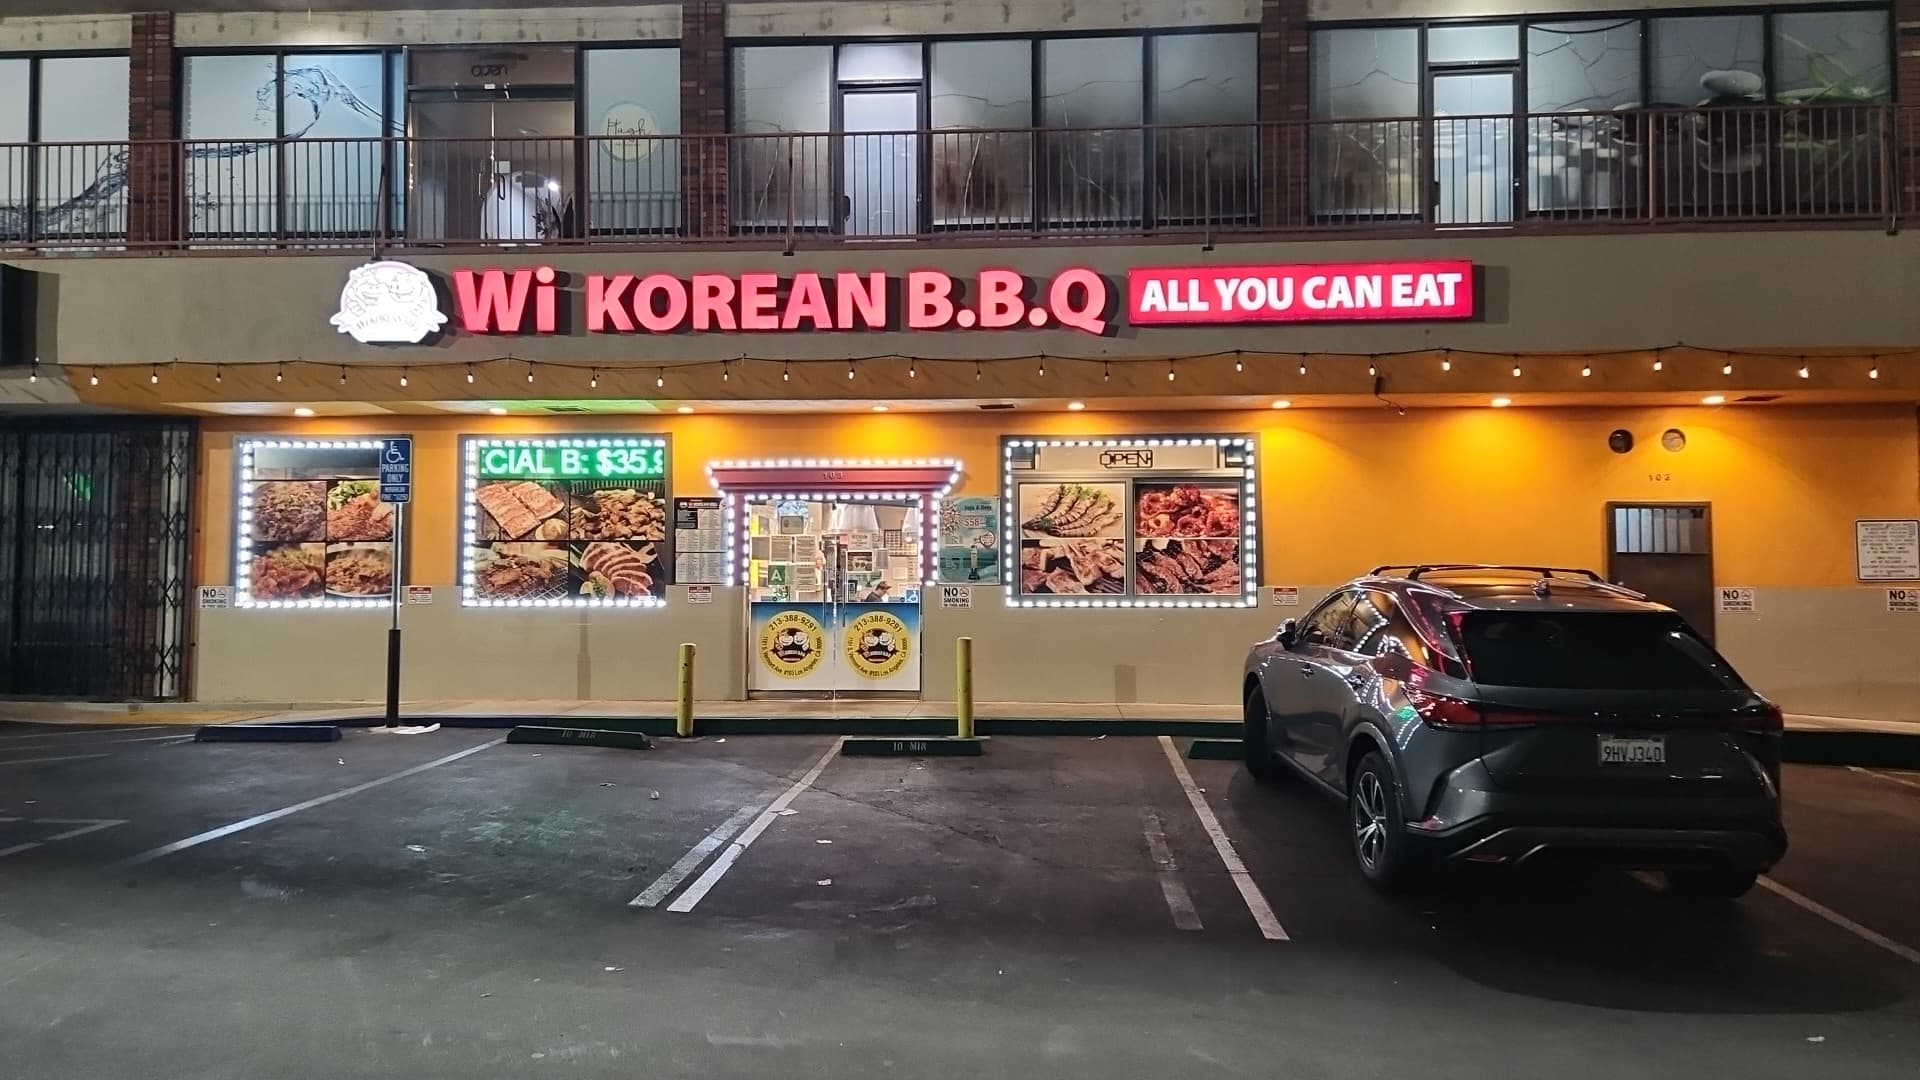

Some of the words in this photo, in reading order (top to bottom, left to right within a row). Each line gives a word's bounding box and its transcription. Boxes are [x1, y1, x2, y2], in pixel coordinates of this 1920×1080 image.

[1140, 279, 1209, 312] ALL
[1214, 277, 1294, 311] YOU
[1302, 275, 1383, 309] CAN
[1391, 273, 1463, 307] EAT
[455, 267, 555, 331] Wi
[587, 272, 886, 331] KOREAN
[908, 269, 1106, 334] B.B.Q
[561, 449, 590, 474] B:
[1099, 450, 1150, 468] OPEN
[381, 463, 409, 472] PARKING
[386, 473, 404, 482] ONLY
[771, 569, 782, 581] A
[202, 588, 216, 597] NO
[943, 587, 958, 597] NO
[1723, 590, 1739, 599] NO
[1889, 590, 1906, 599] NO
[768, 614, 817, 632] 213-388-9291
[854, 615, 903, 632] 213-388-9291
[893, 741, 903, 751] 10
[1603, 746, 1663, 762] 9HVJ340
